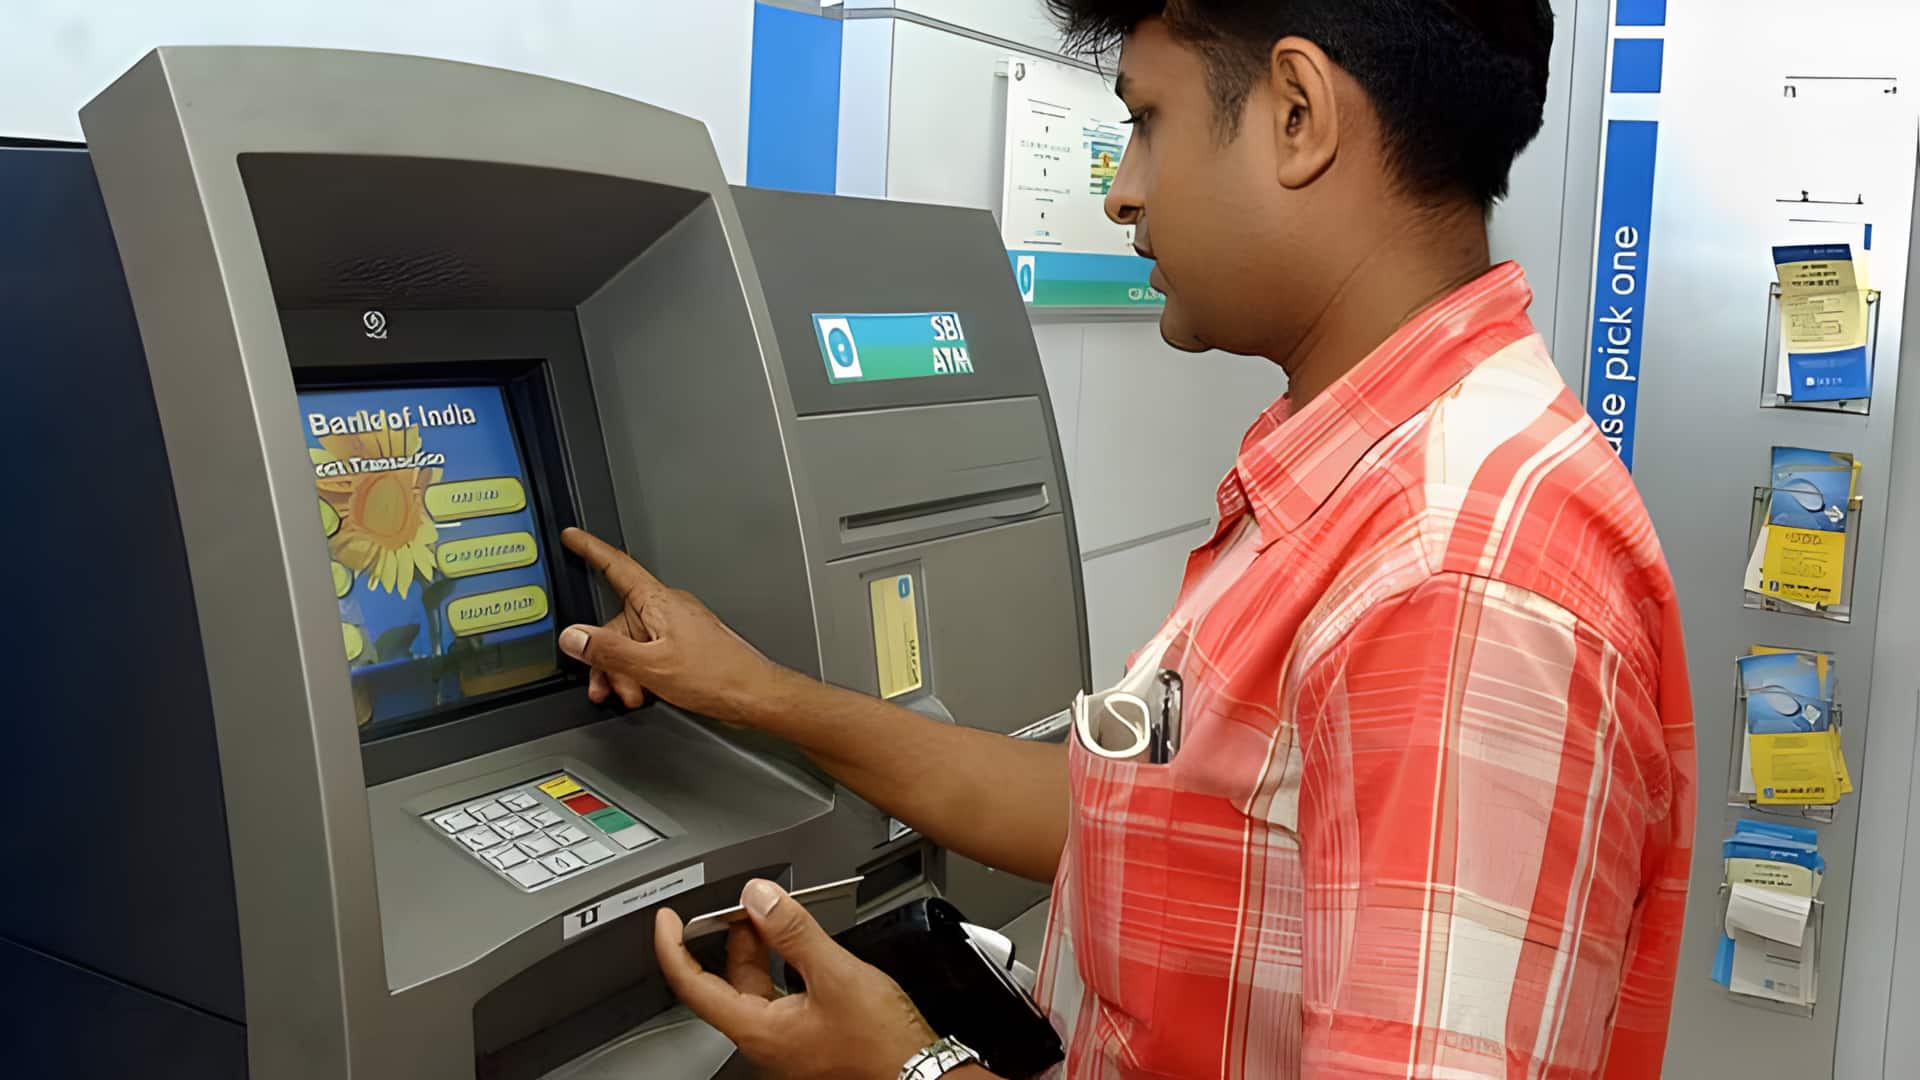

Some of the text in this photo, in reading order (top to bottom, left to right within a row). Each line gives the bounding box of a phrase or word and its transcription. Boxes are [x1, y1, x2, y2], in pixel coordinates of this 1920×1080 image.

[1611, 226, 1638, 295] one
[930, 312, 964, 341] SBI
[1597, 306, 1636, 381] pick
[388, 405, 412, 431] of
[418, 403, 477, 428] India
